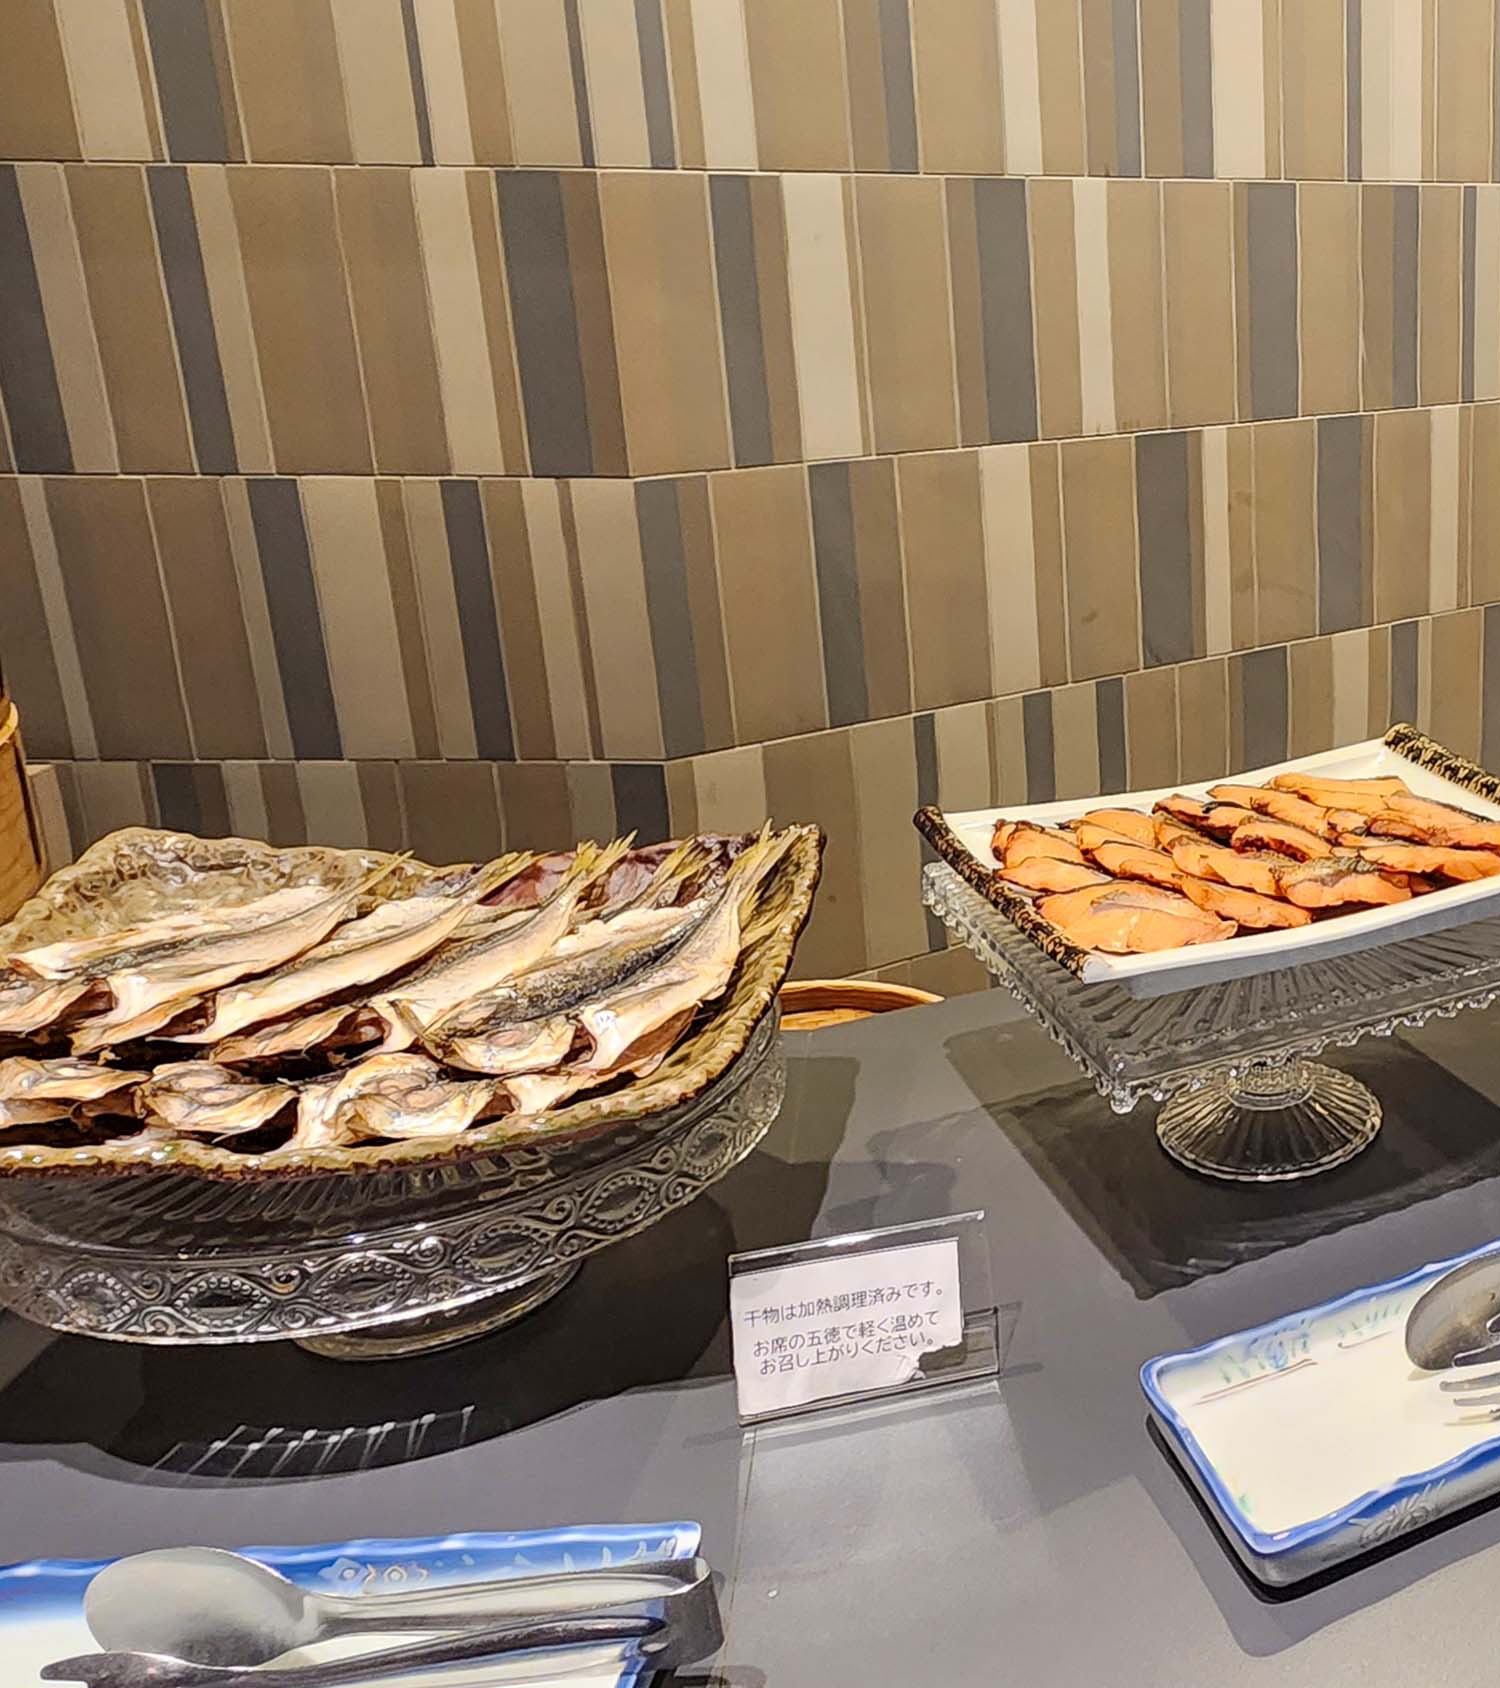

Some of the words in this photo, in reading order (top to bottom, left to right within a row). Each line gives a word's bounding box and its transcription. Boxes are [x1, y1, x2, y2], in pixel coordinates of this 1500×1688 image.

[744, 1281, 943, 1328] 干物は加熱調理済みです。
[753, 1311, 939, 1358] お席の五徳で軽く温めて
[760, 1332, 934, 1375] お召し上がりください。
